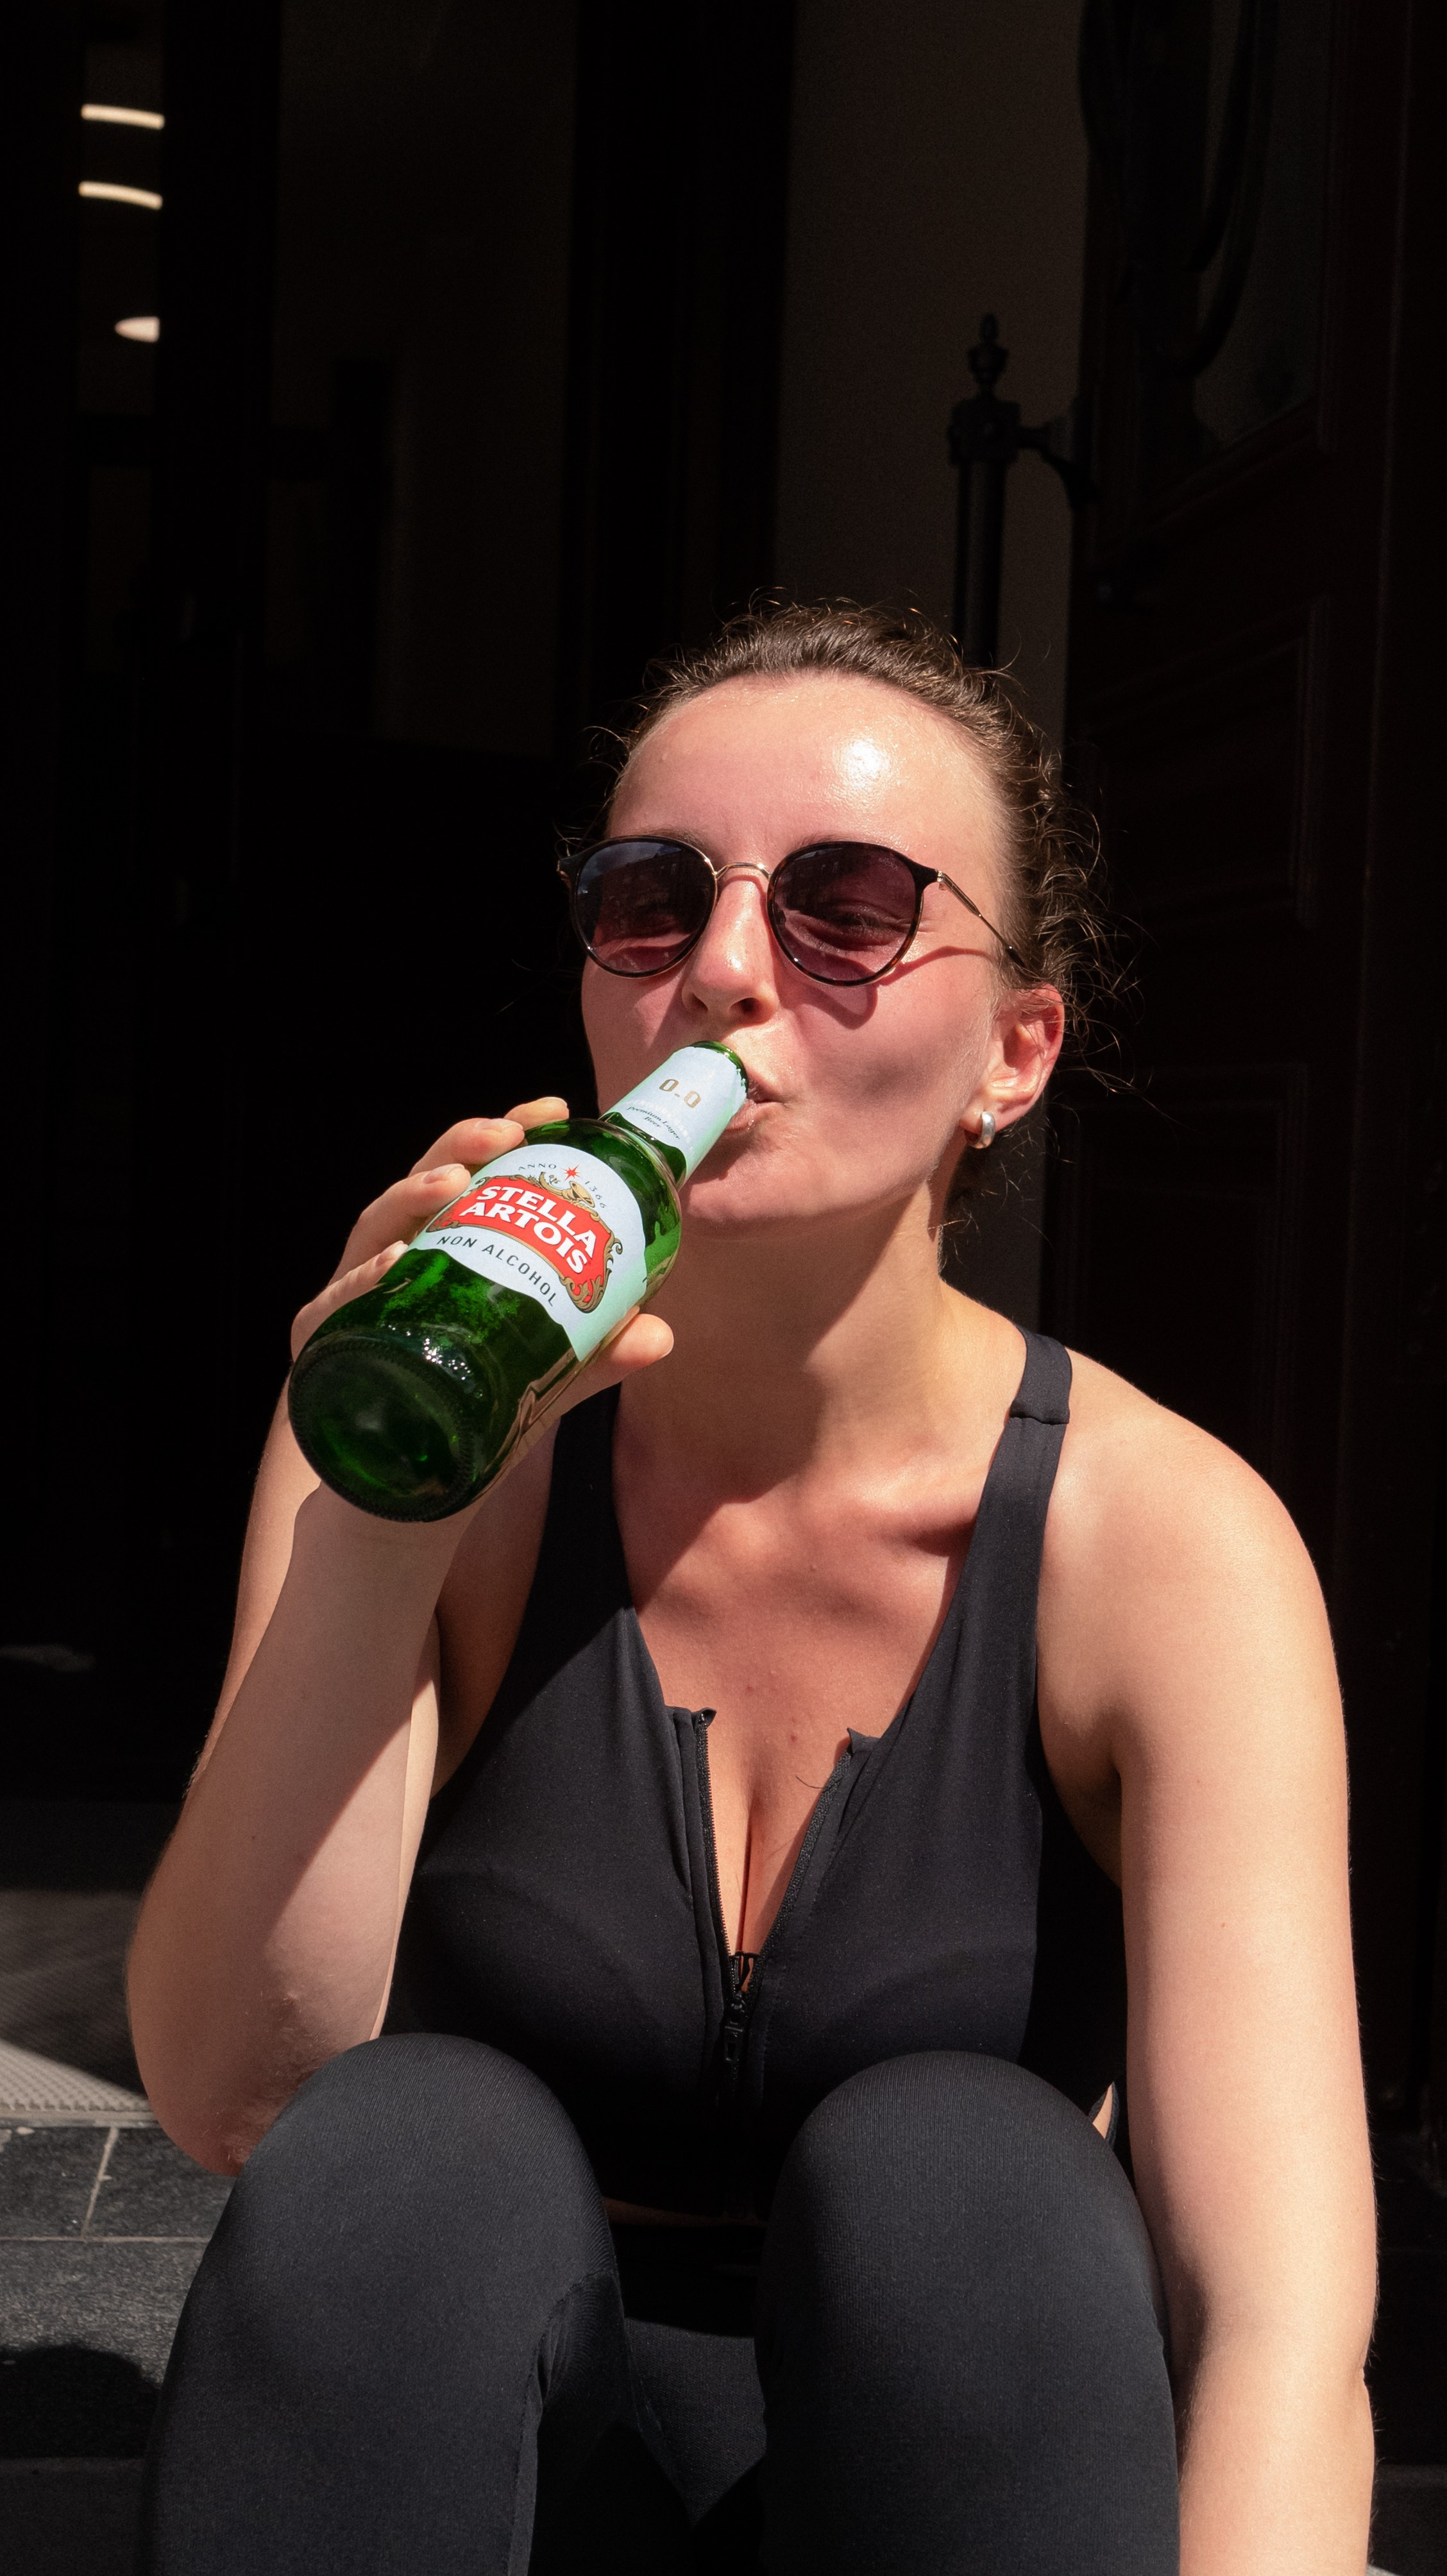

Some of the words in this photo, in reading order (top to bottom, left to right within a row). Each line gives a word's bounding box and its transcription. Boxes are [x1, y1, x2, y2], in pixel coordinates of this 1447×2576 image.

[659, 1079, 702, 1108] 0.0
[626, 1106, 662, 1121] Premium
[661, 1121, 680, 1139] Lager
[643, 1116, 661, 1128] Beer
[518, 1163, 557, 1171] ANNO
[584, 1181, 607, 1208] 1366
[459, 1201, 588, 1274] ARTOIS
[476, 1186, 597, 1258] STELLA
[436, 1236, 477, 1248] NON
[482, 1244, 557, 1307] ALCOHOL
